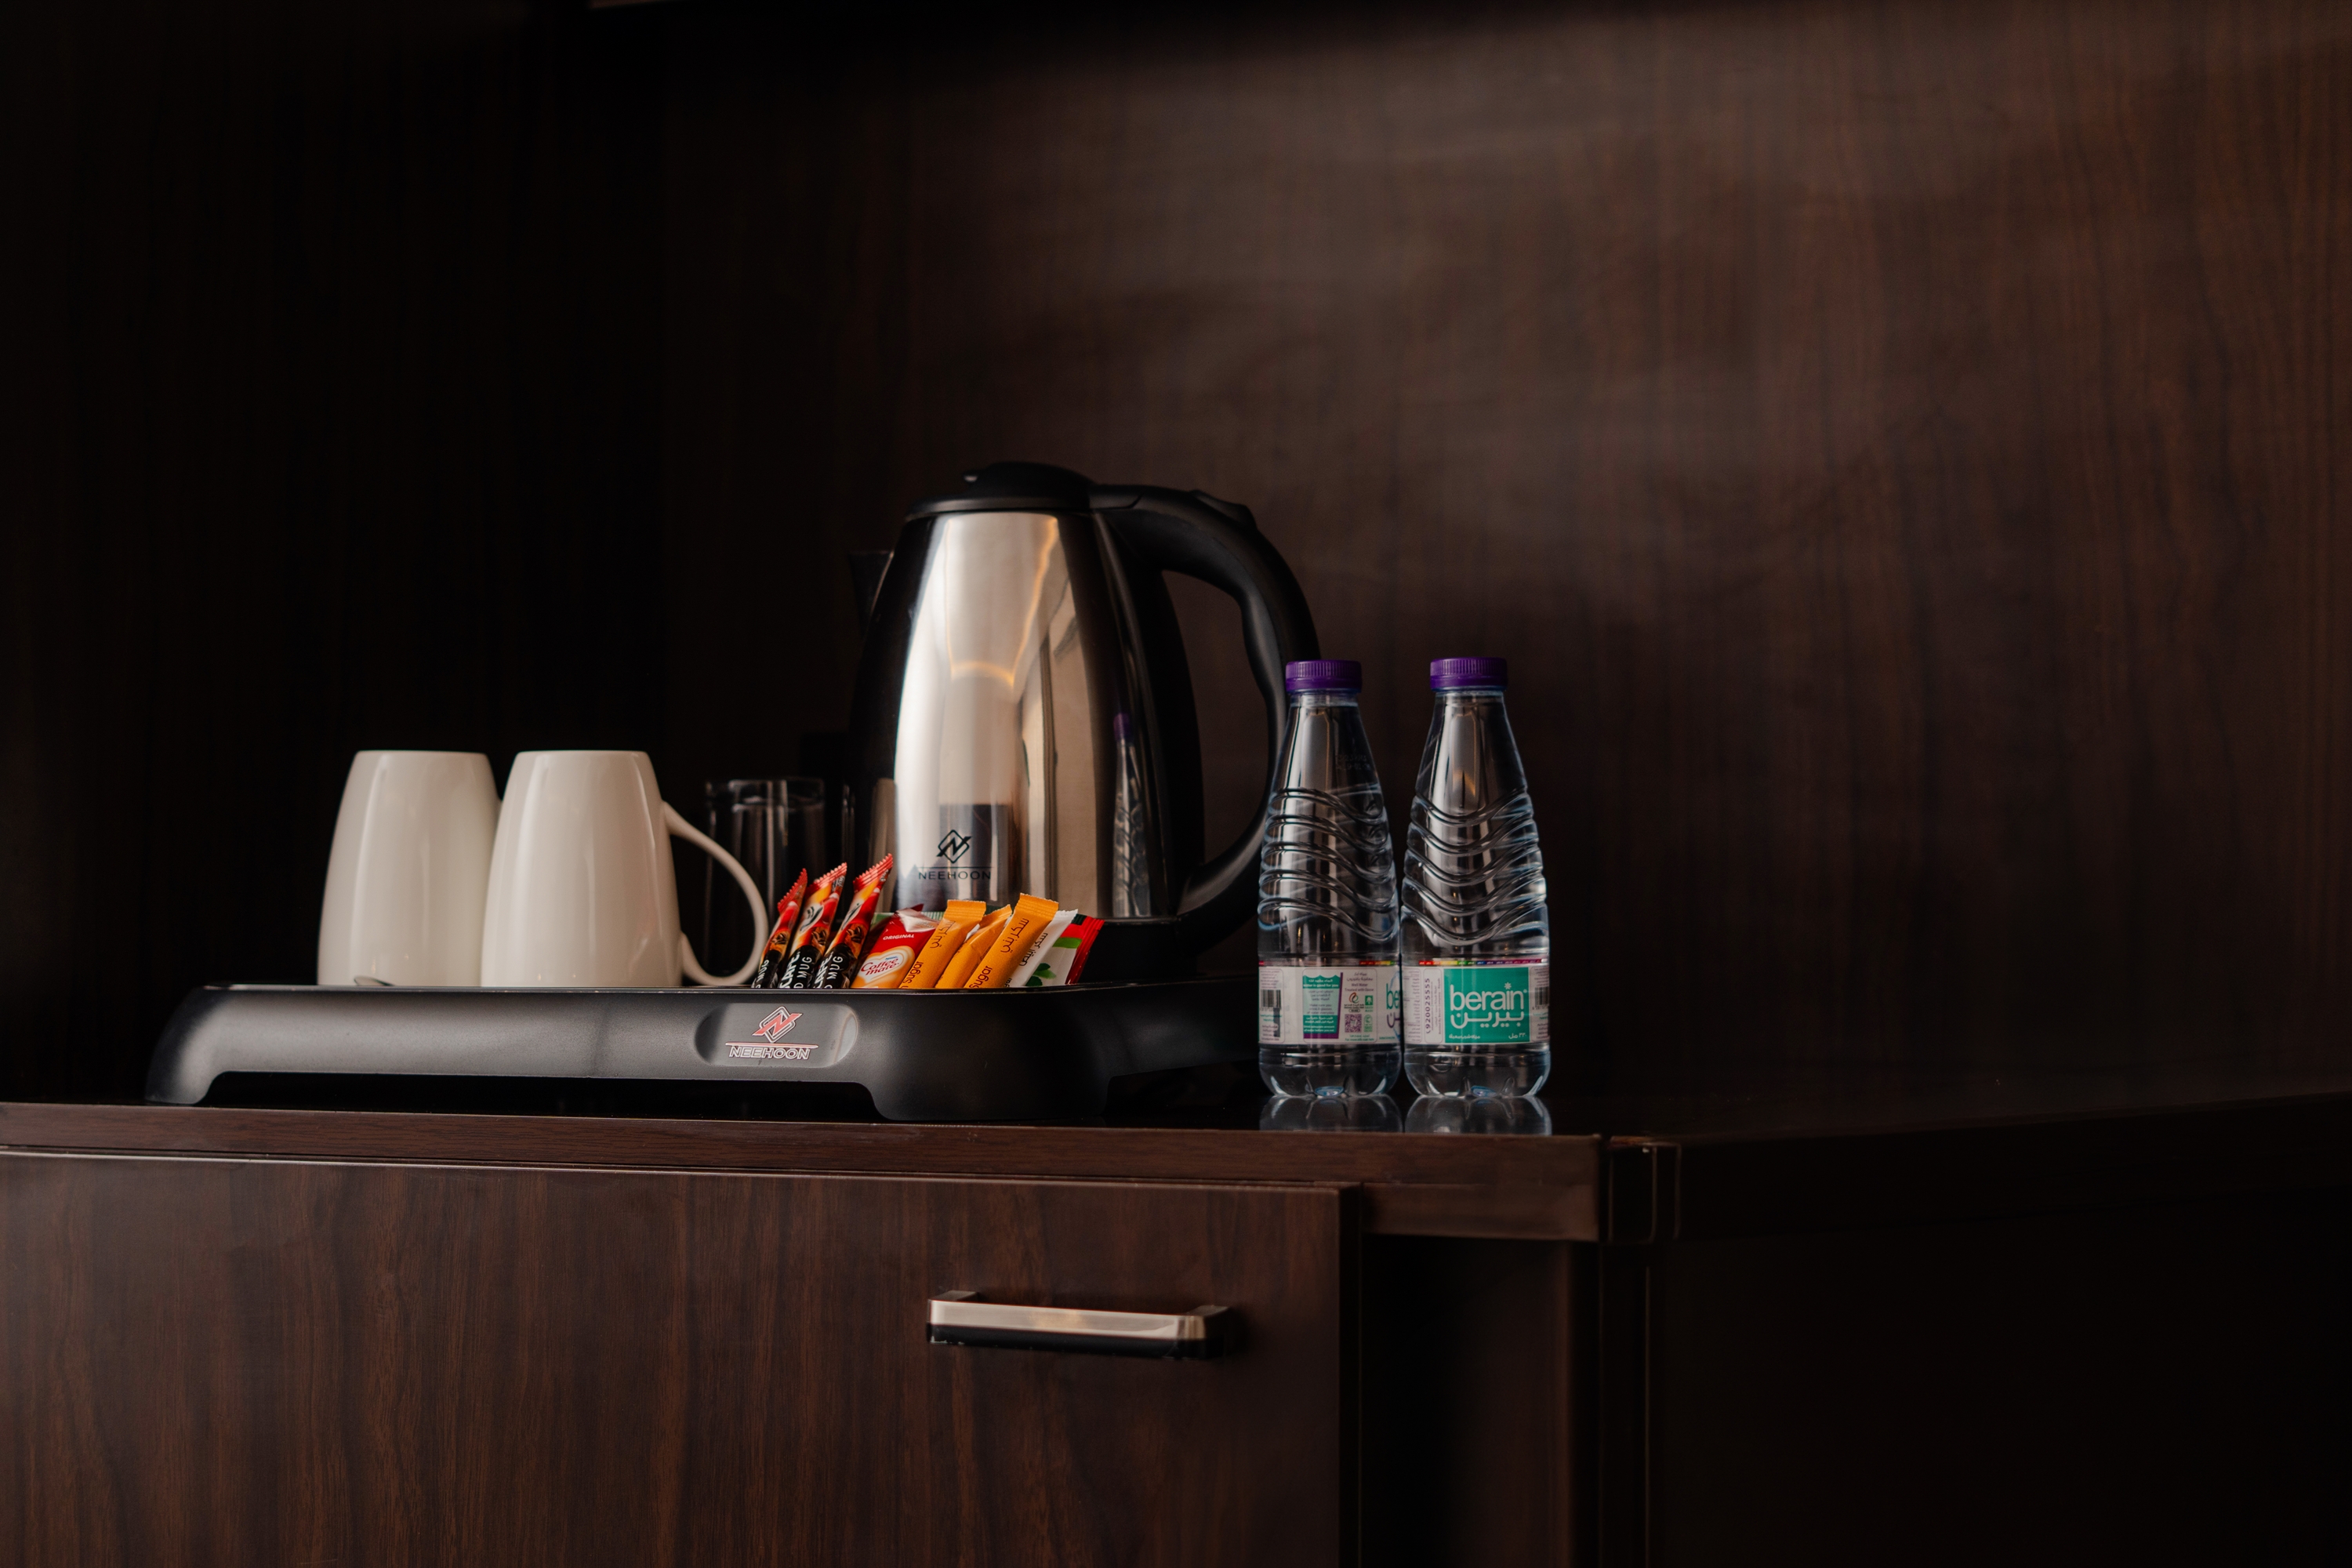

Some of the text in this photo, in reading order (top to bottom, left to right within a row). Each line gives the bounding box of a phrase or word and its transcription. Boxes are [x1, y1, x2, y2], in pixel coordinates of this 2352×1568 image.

[918, 871, 991, 880] NEEHOON
[930, 920, 956, 949] سكر بني
[1000, 918, 1029, 953] سكر بني
[1034, 932, 1048, 949] سكر
[797, 956, 812, 978] MUG
[826, 956, 844, 979] MUG
[861, 958, 898, 972] Coffee
[865, 963, 899, 976] mate
[1450, 982, 1524, 1011] berain
[1450, 1011, 1524, 1029] بيرين
[728, 1047, 811, 1060] NEEHOON
